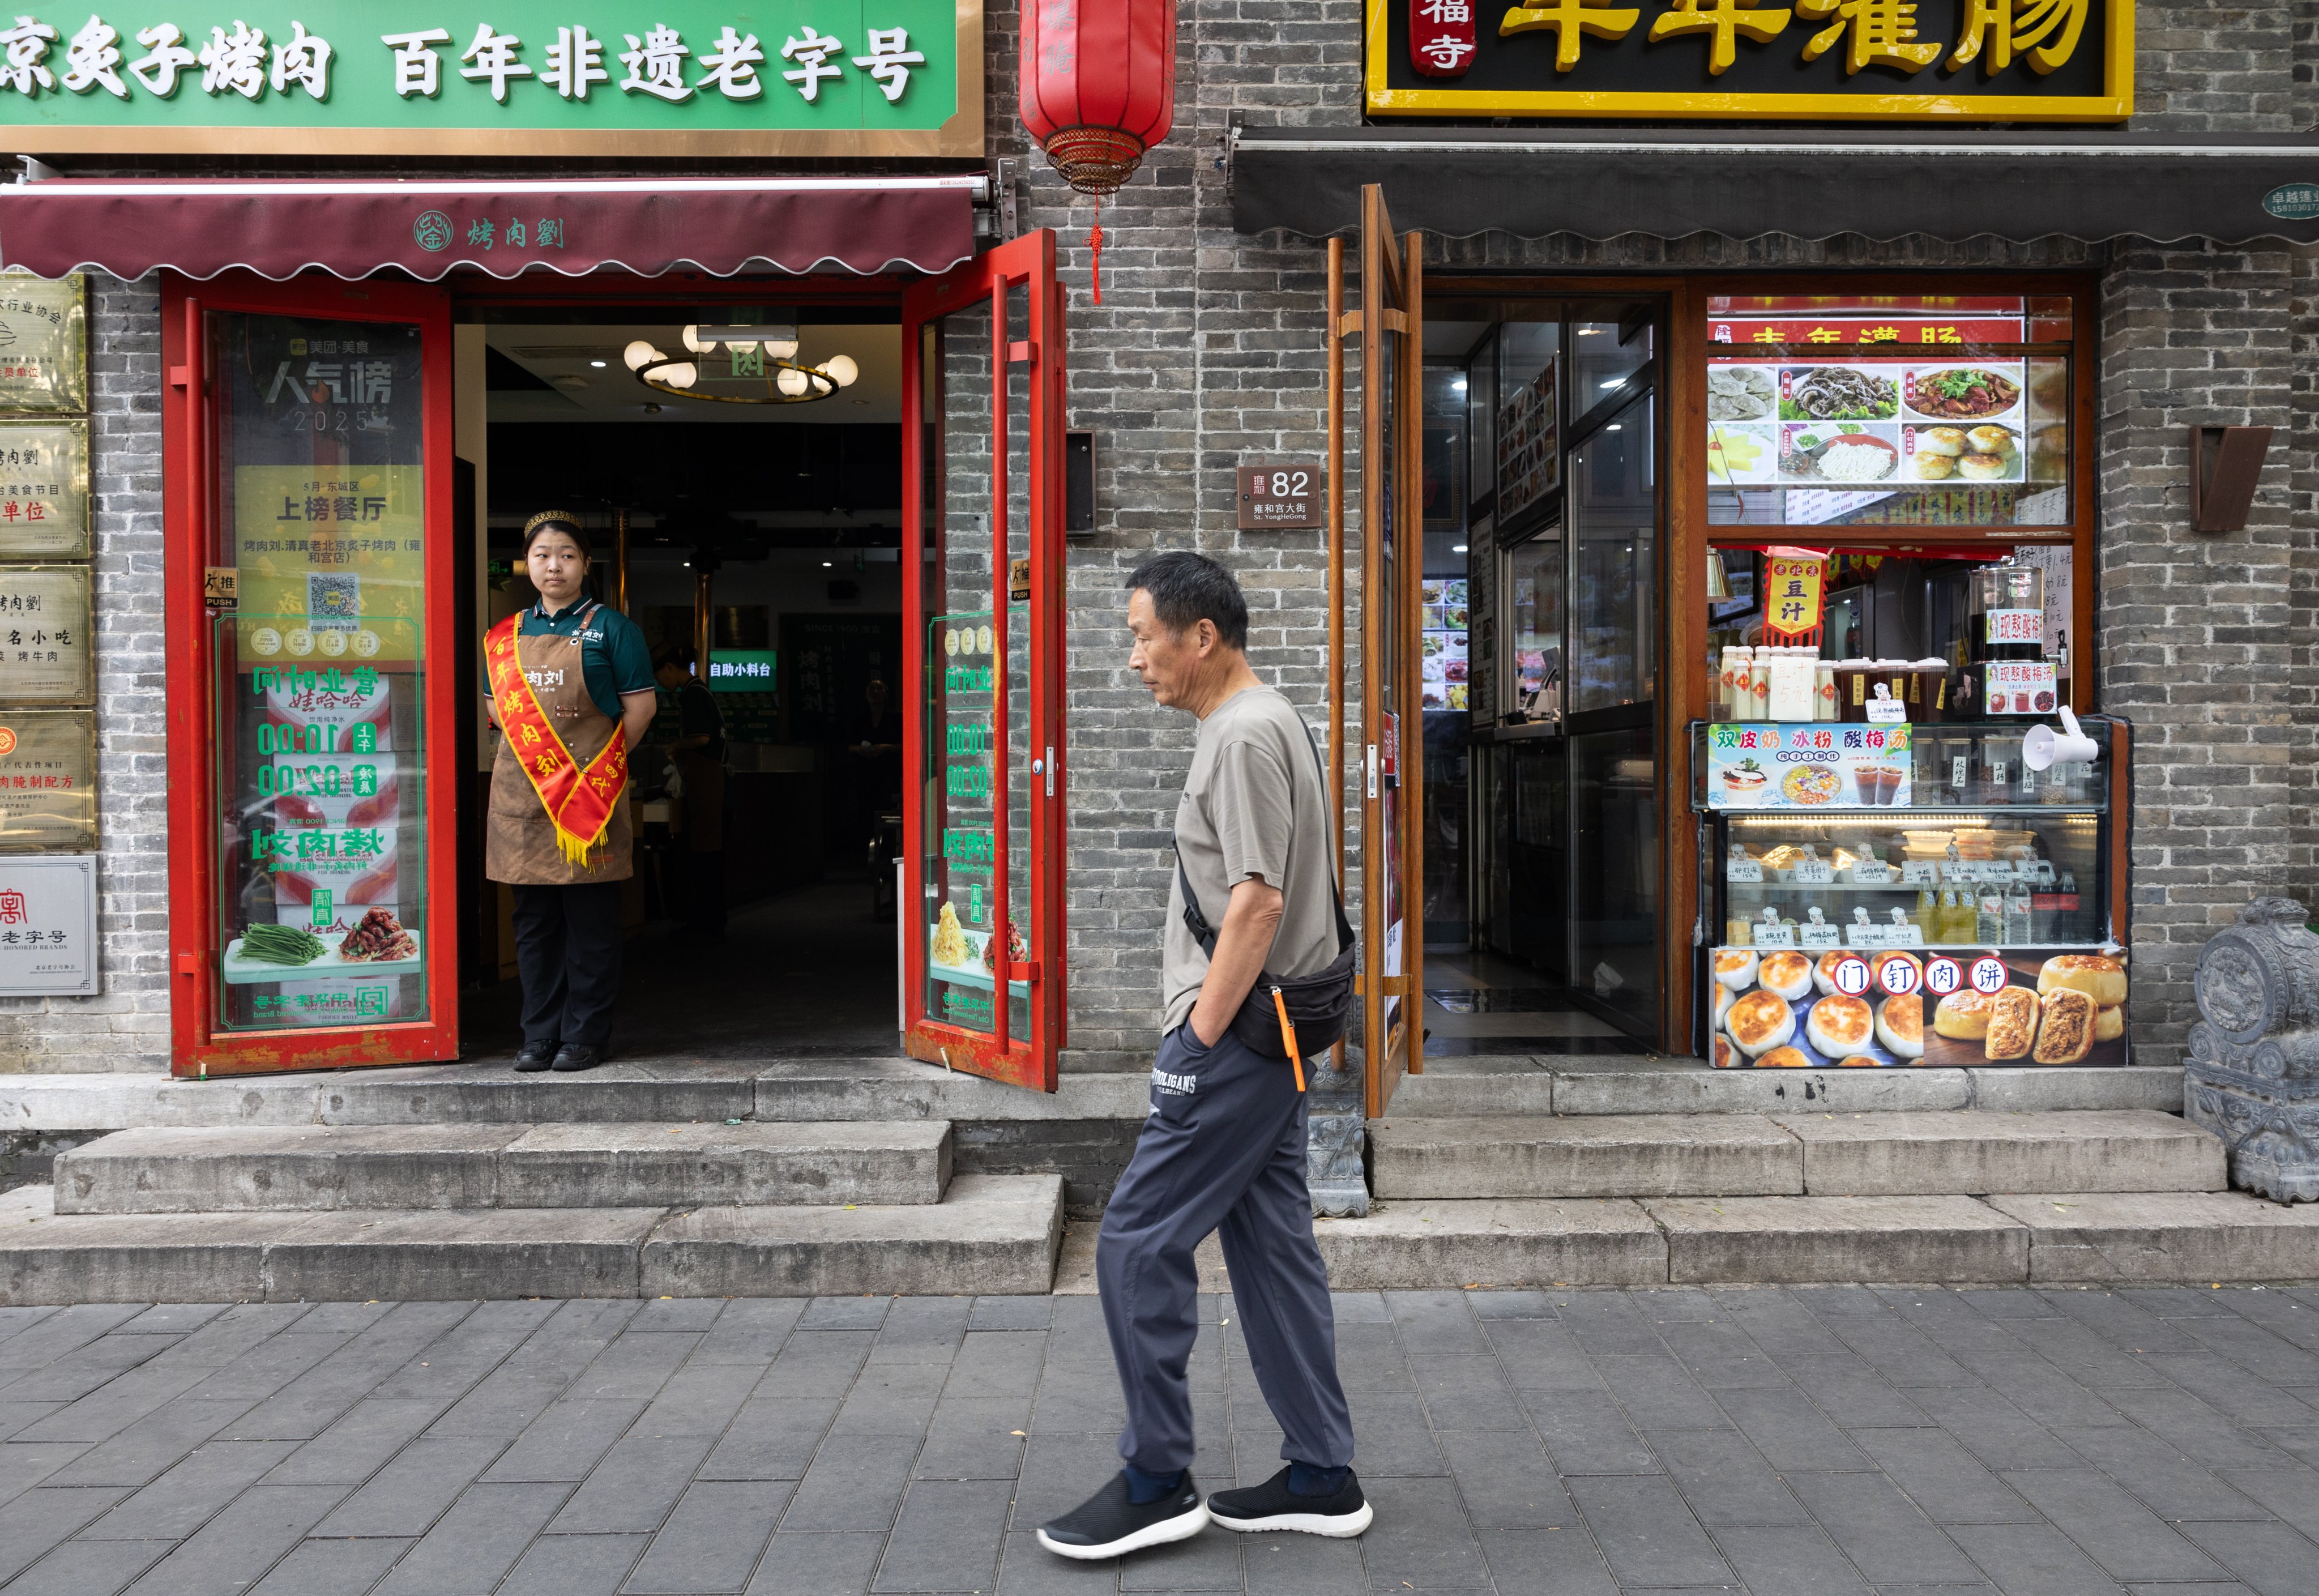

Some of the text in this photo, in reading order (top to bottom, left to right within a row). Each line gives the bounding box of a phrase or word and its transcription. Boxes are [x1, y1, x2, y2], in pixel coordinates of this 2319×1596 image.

[0, 14, 926, 105] 京炙子烤肉 百年非遗老字号
[467, 217, 563, 250] 烤肉劉
[265, 361, 391, 404] 人气榜
[294, 411, 368, 431] 2025
[1272, 472, 1308, 497] 82
[2, 501, 45, 522] 单位
[277, 496, 386, 522] 上榜餐厅
[1254, 503, 1306, 514] 雍和宫大街
[1775, 564, 1820, 577] 老北京
[220, 576, 235, 589] 推
[1781, 579, 1808, 622] 豆汁
[7, 629, 72, 646] 名小吃
[18, 651, 57, 662] 烤牛肉
[710, 663, 771, 677] 自助小料台
[1776, 662, 1807, 681] 豆汁
[2000, 666, 2053, 682] 现熬酸梅汤
[1780, 684, 1806, 703] 5元
[1716, 729, 1908, 749] 双皮奶 冰粉 酸梅汤
[1779, 752, 1837, 761] 纯手工制作
[2, 931, 67, 944] 老字号
[1843, 963, 2001, 989] 门钉肉饼
